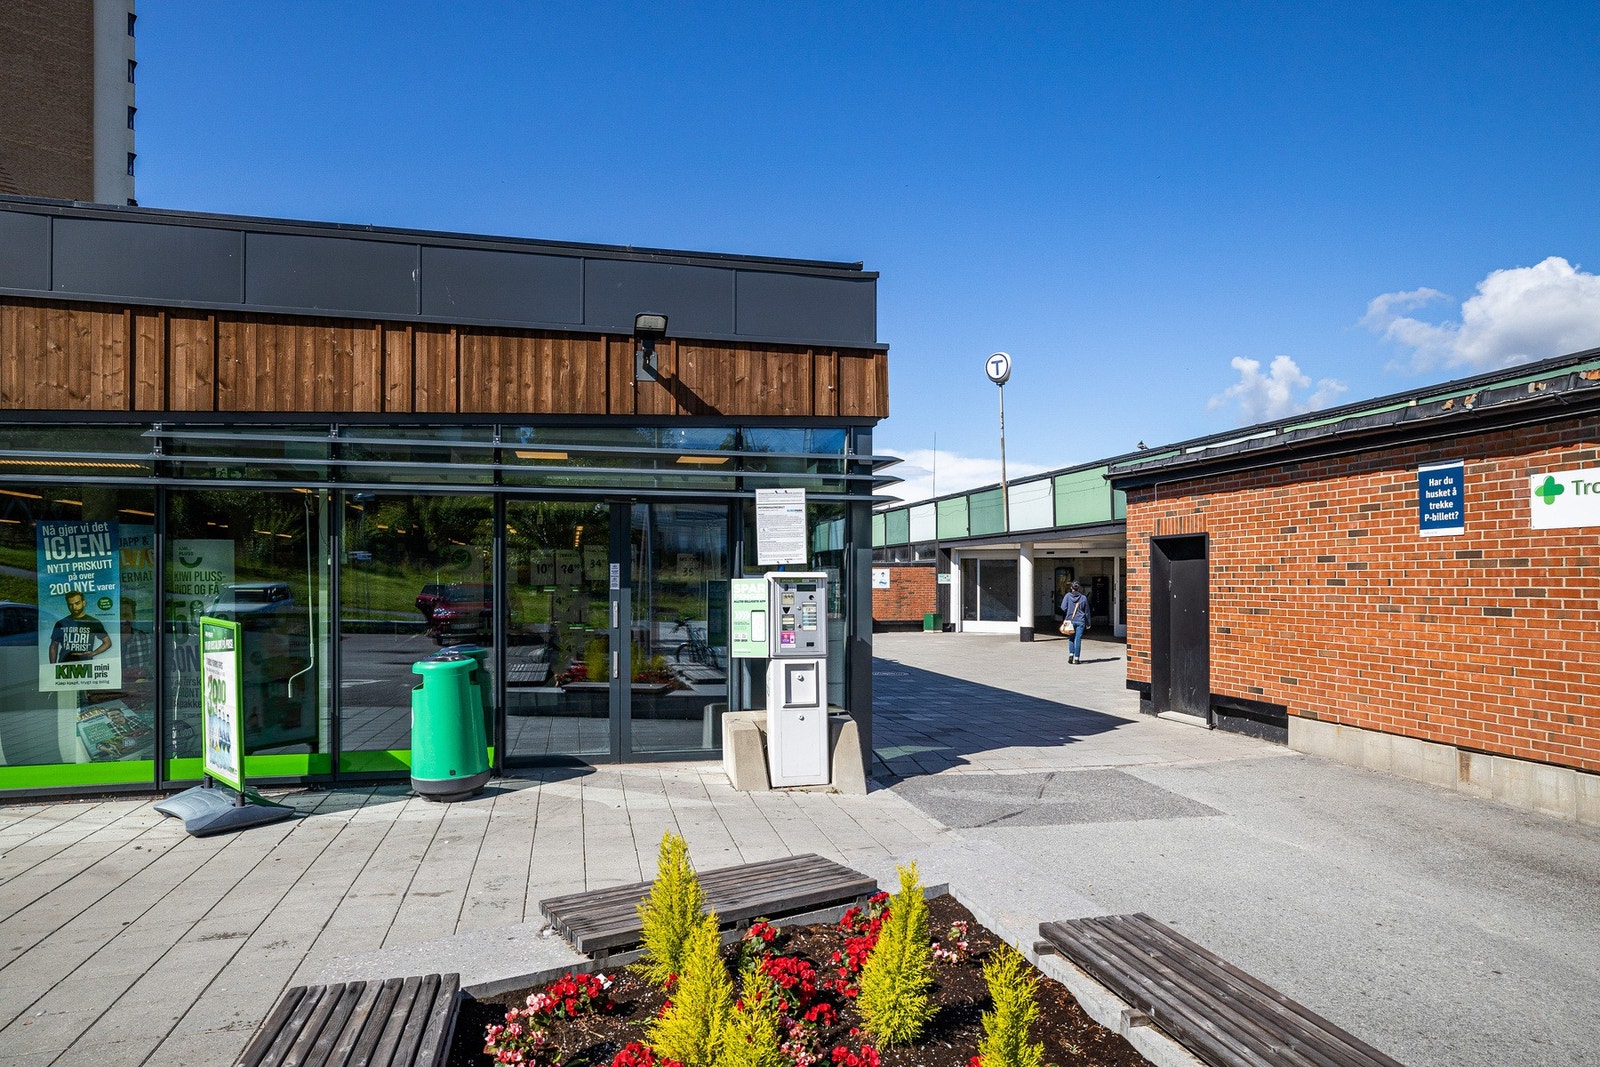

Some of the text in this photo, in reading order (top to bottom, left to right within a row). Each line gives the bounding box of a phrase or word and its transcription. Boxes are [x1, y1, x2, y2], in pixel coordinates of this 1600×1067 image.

[991, 359, 1003, 376] T
[1428, 476, 1454, 487] Har du
[1425, 486, 1457, 499] husket å
[1429, 500, 1454, 510] trekke
[1424, 511, 1459, 522] P-billett?
[42, 521, 109, 537] Nå gjør vi det
[44, 532, 112, 561] IGJEN!
[47, 559, 113, 574] NYTT PRISKUTT
[68, 572, 95, 582] på over
[174, 570, 226, 582] KIWI PLUSS-
[49, 582, 72, 596] 200
[73, 580, 95, 594] NYE
[97, 583, 116, 591] varer
[194, 584, 206, 595] OG
[208, 581, 220, 595] FÅ
[733, 583, 766, 594] SPAR
[63, 633, 89, 644] ALDRI
[55, 663, 110, 680] KIWI mini
[94, 670, 108, 679] pris
